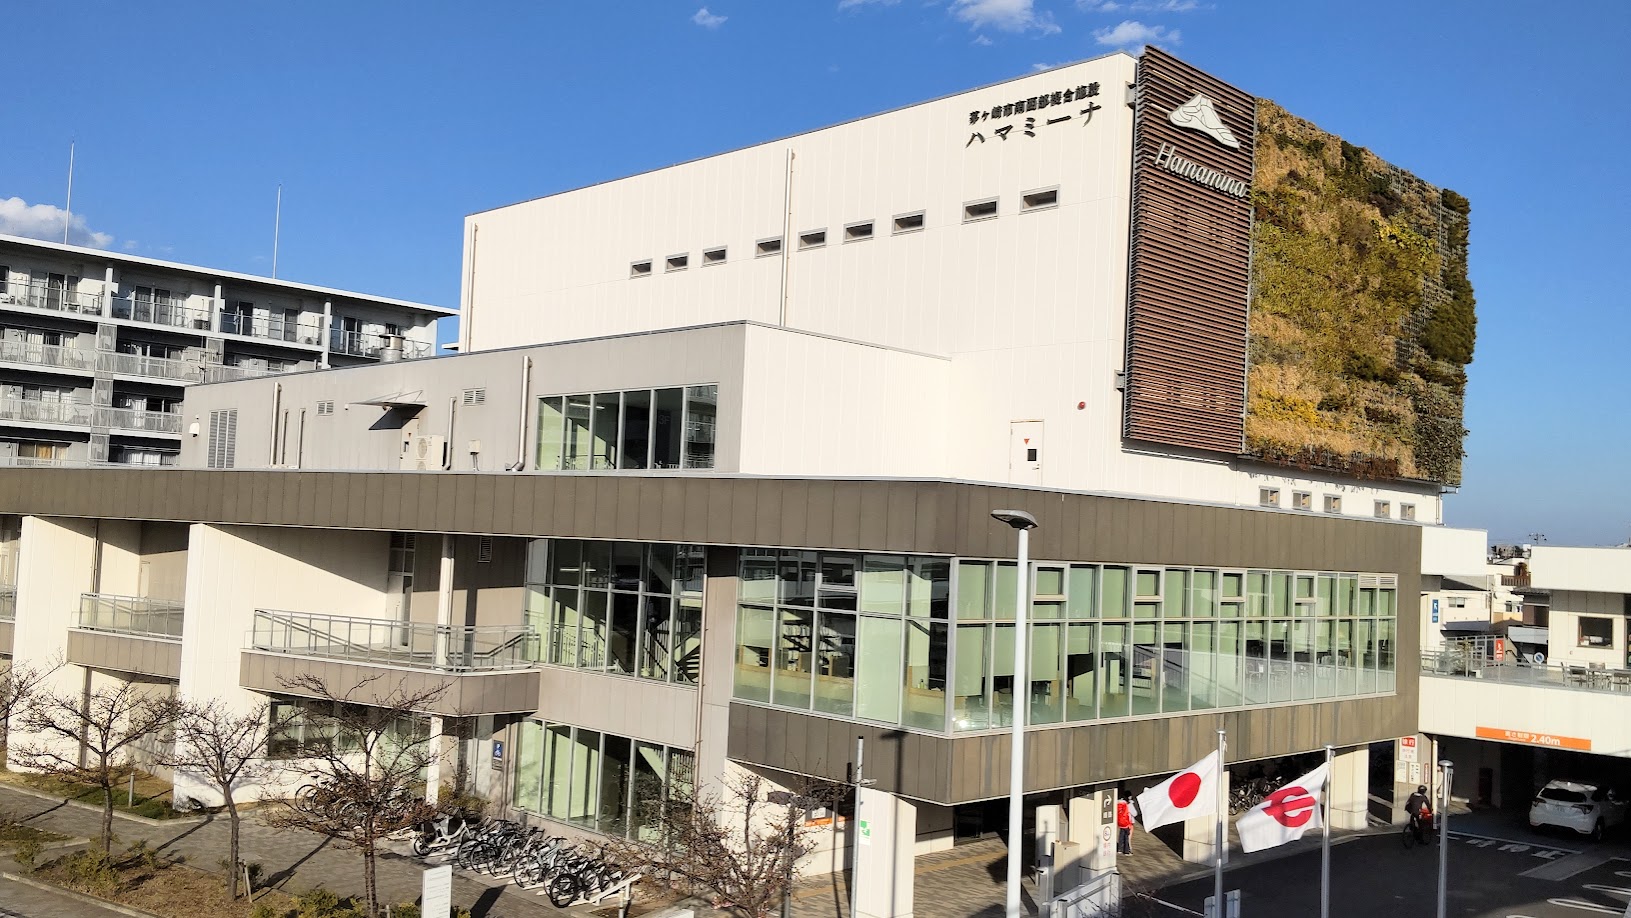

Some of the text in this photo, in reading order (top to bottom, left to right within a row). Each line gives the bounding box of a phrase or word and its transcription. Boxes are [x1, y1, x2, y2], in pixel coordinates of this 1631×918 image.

[965, 101, 1102, 148] ハマミーナ
[1154, 142, 1247, 198] Hamamina
[1530, 734, 1561, 746] 2.40m
